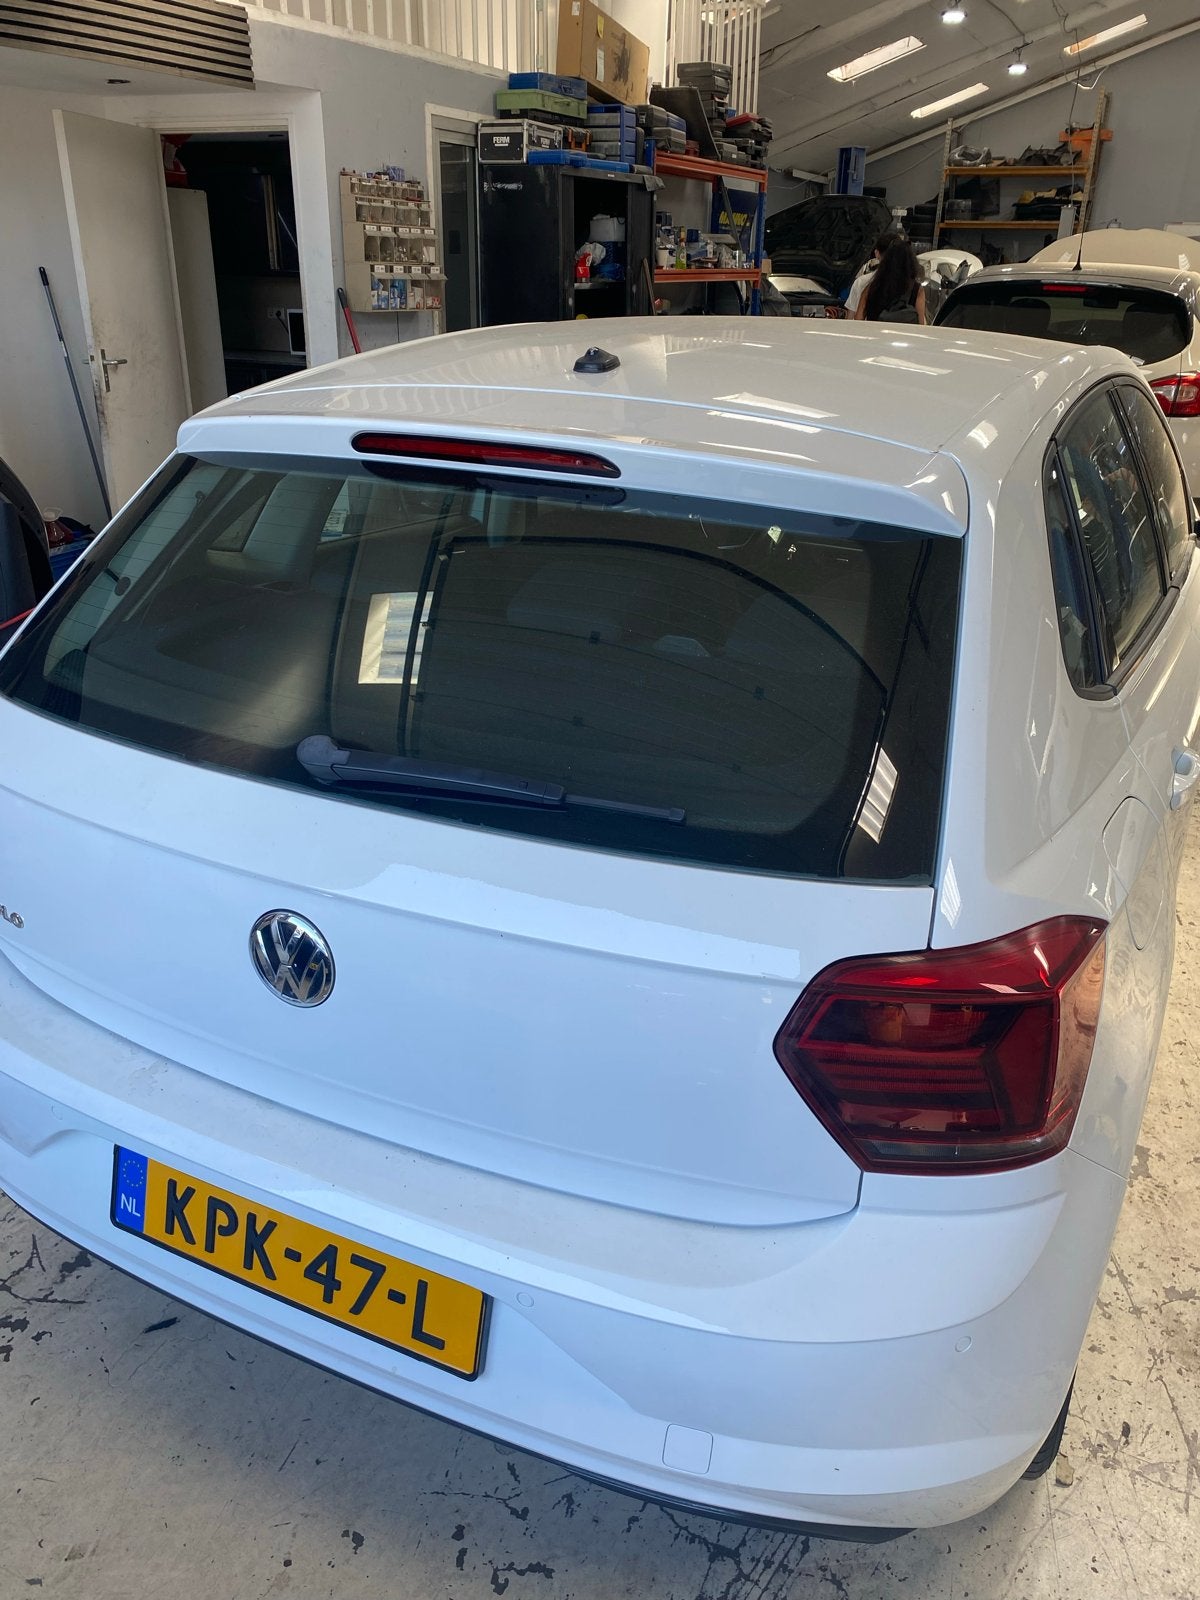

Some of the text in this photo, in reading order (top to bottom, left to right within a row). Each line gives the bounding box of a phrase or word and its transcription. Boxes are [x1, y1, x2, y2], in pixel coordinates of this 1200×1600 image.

[493, 136, 510, 144] FERM
[120, 1192, 141, 1217] NL
[164, 1178, 446, 1350] KPK-47-L
